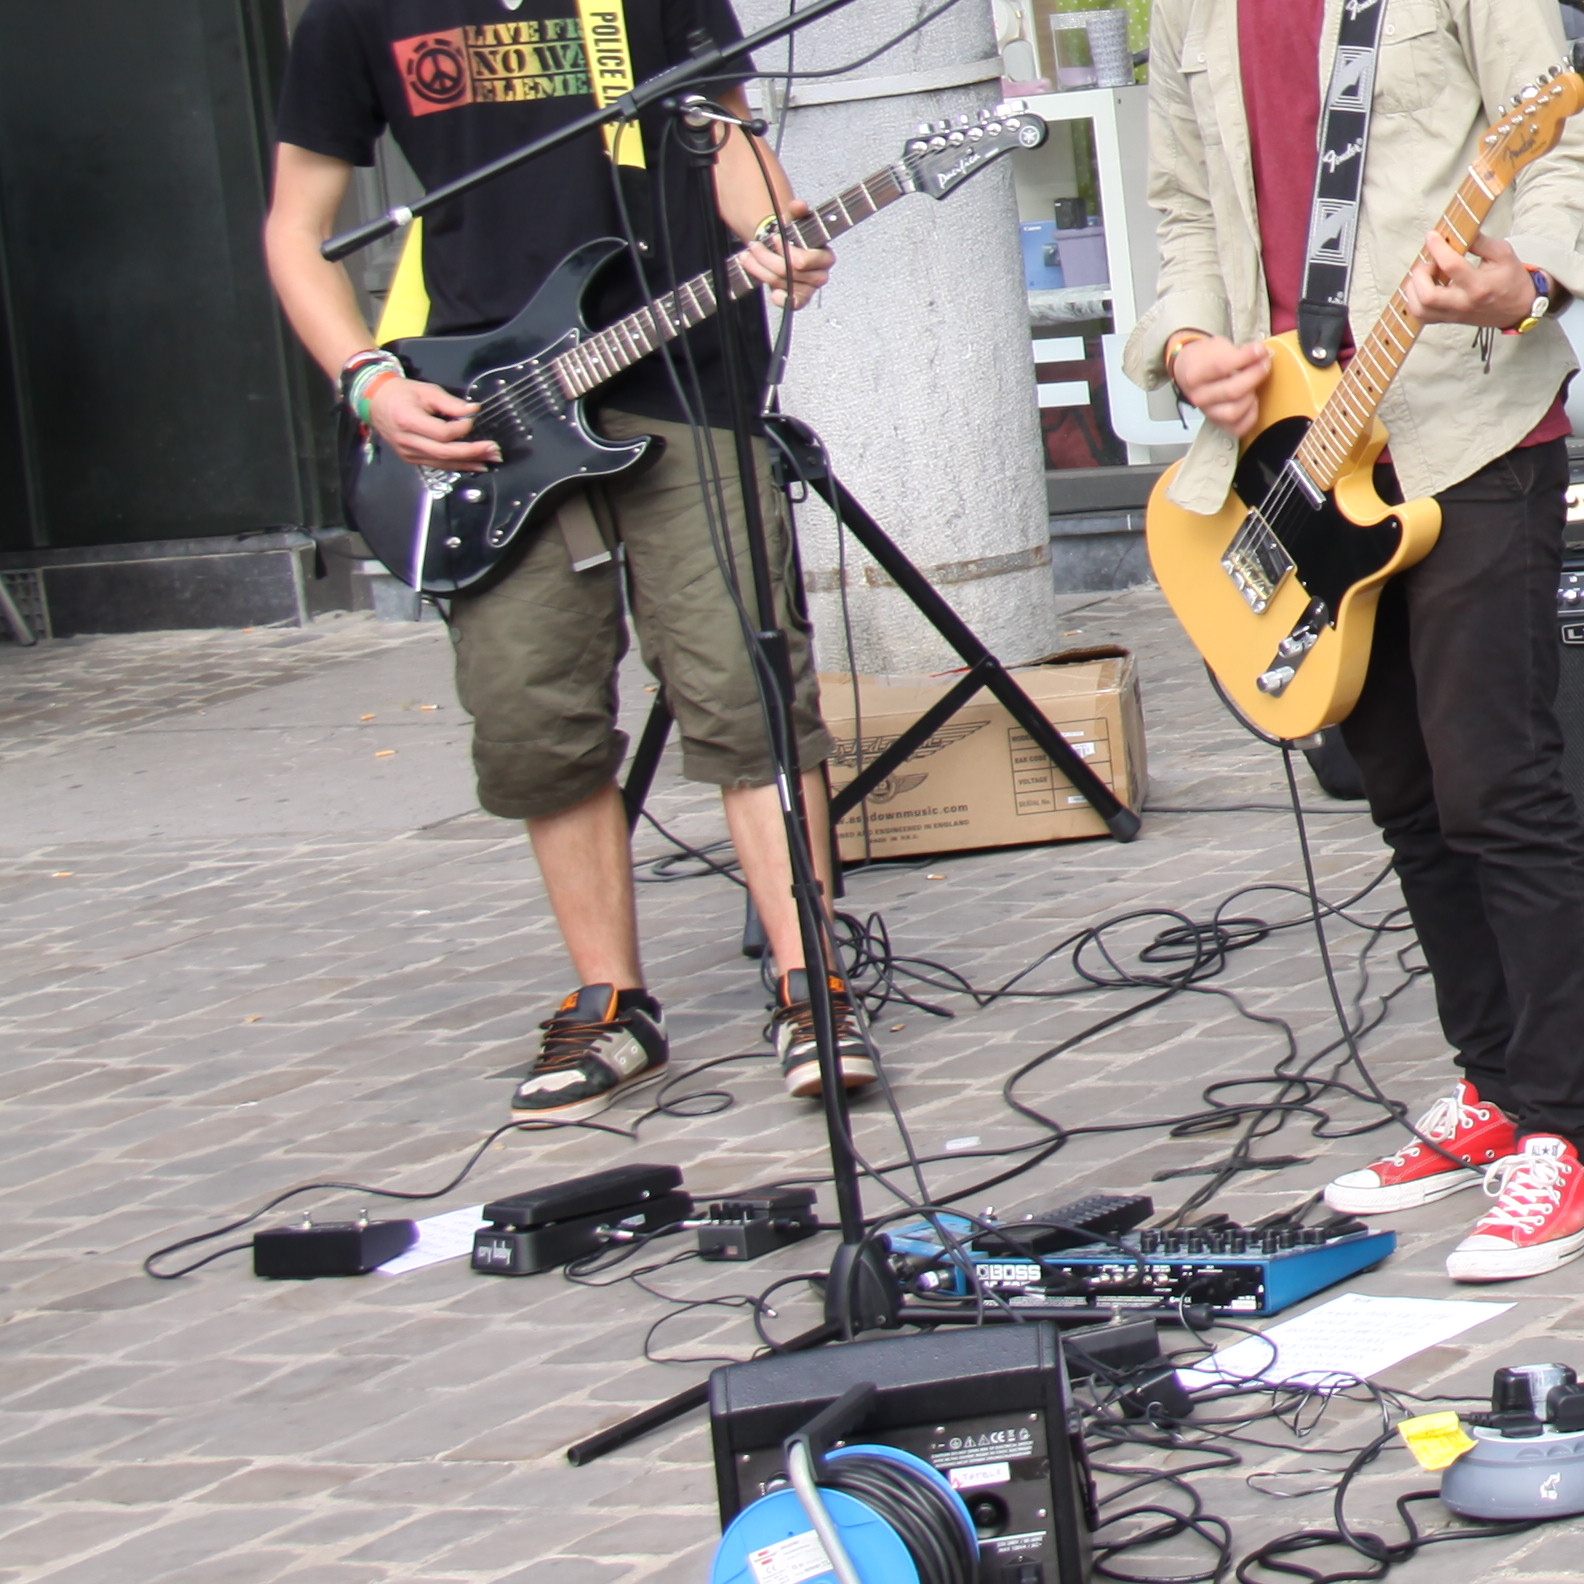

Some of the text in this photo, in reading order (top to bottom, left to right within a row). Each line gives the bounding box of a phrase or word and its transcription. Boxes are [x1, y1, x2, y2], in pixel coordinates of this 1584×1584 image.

[465, 20, 540, 46] LIVE
[473, 44, 588, 79] NO WA
[590, 11, 627, 87] POLICE
[473, 74, 592, 103] ELEME
[1018, 777, 1048, 785] VOLTAGE
[933, 819, 970, 829] ENGLAND
[990, 1264, 1041, 1280] BOSS
